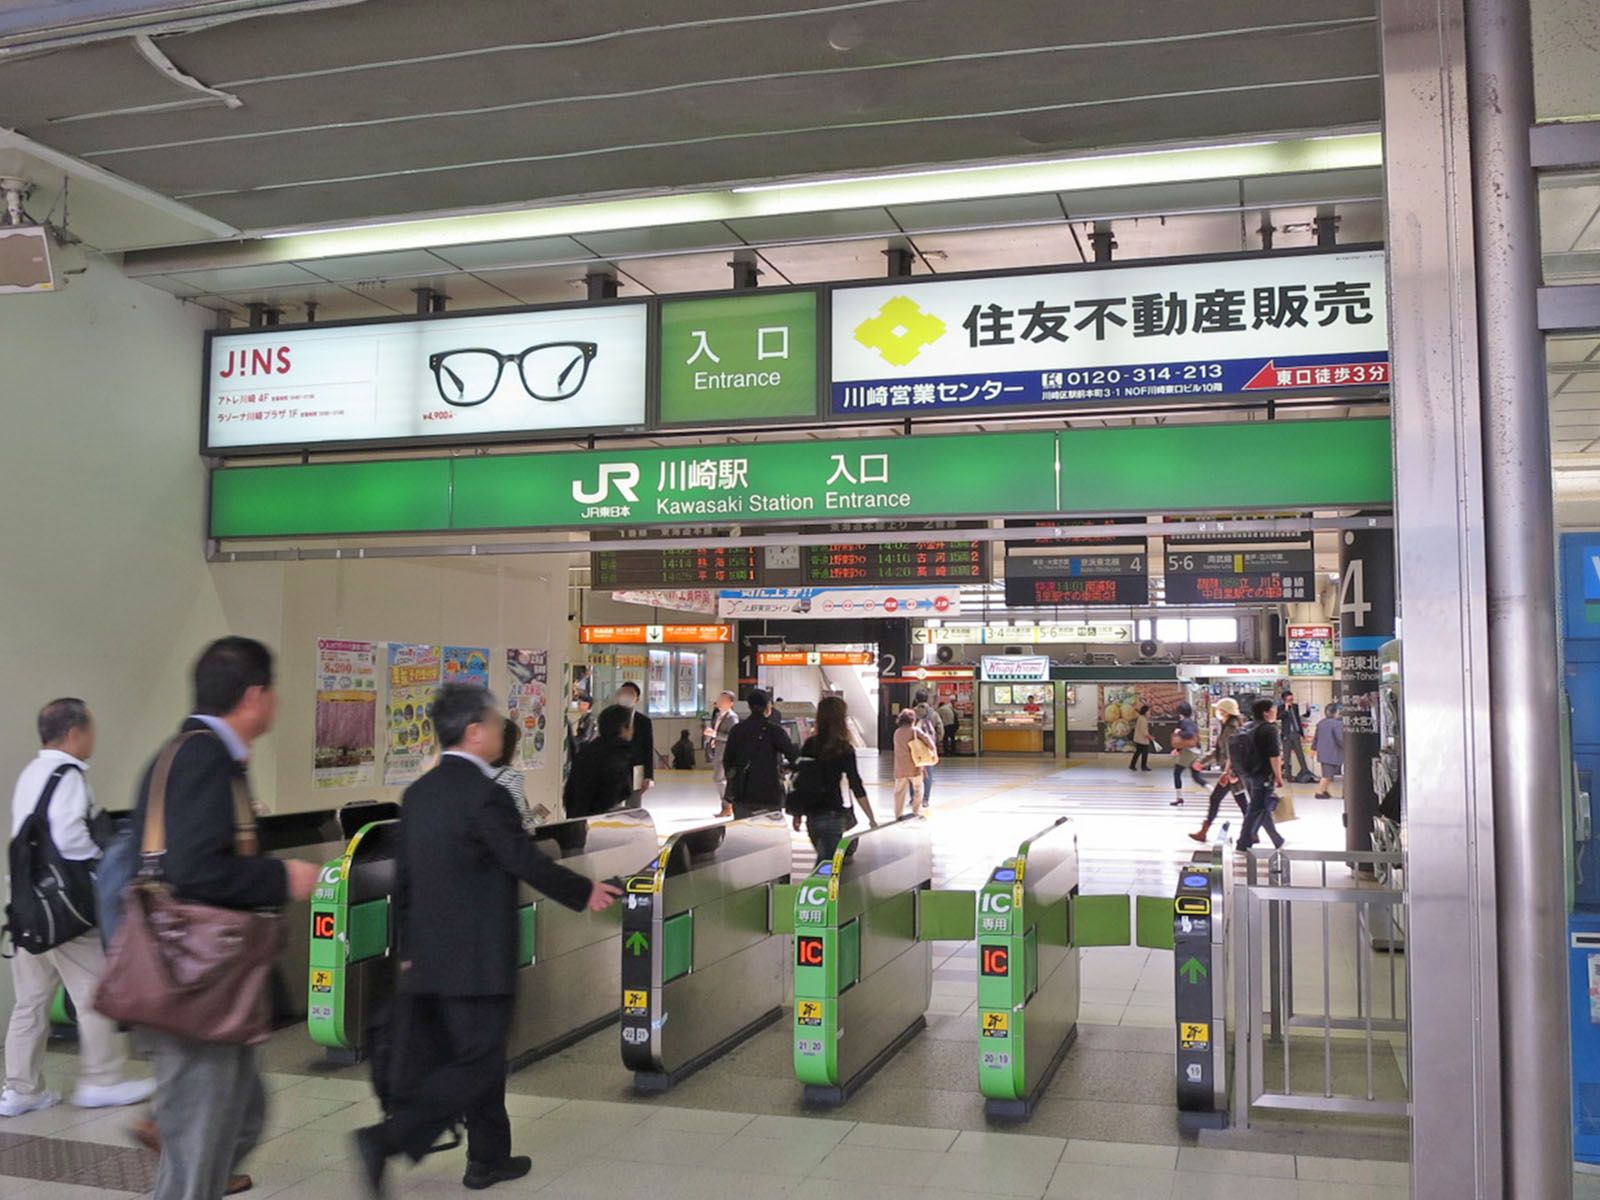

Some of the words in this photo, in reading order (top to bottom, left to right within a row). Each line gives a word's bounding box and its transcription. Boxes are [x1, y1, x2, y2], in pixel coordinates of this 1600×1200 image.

[963, 281, 1374, 348] 住友不動産販売
[694, 370, 781, 391] Entrance
[1067, 364, 1223, 386] 0120-314-213
[1276, 365, 1385, 386] 東口徒歩3分
[843, 379, 1025, 409] 川崎営業センター
[571, 461, 641, 505] JR
[656, 458, 749, 492] 川崎駅
[825, 453, 889, 486] 入口
[581, 505, 631, 520] JR東日本
[656, 496, 743, 516] Kawasaki
[749, 494, 814, 512] Station
[825, 490, 911, 510] Entrance
[971, 551, 980, 563] 2
[1130, 556, 1142, 573] 4
[971, 565, 980, 577] 2
[1340, 558, 1372, 628] 4
[583, 627, 592, 642] 1
[719, 625, 729, 641] 2
[881, 653, 897, 677] 2
[316, 866, 342, 884] IC
[798, 886, 827, 906] IC
[981, 892, 1011, 913] IC
[314, 915, 335, 937] IC
[800, 941, 823, 964] IC
[983, 949, 1007, 974] IC
